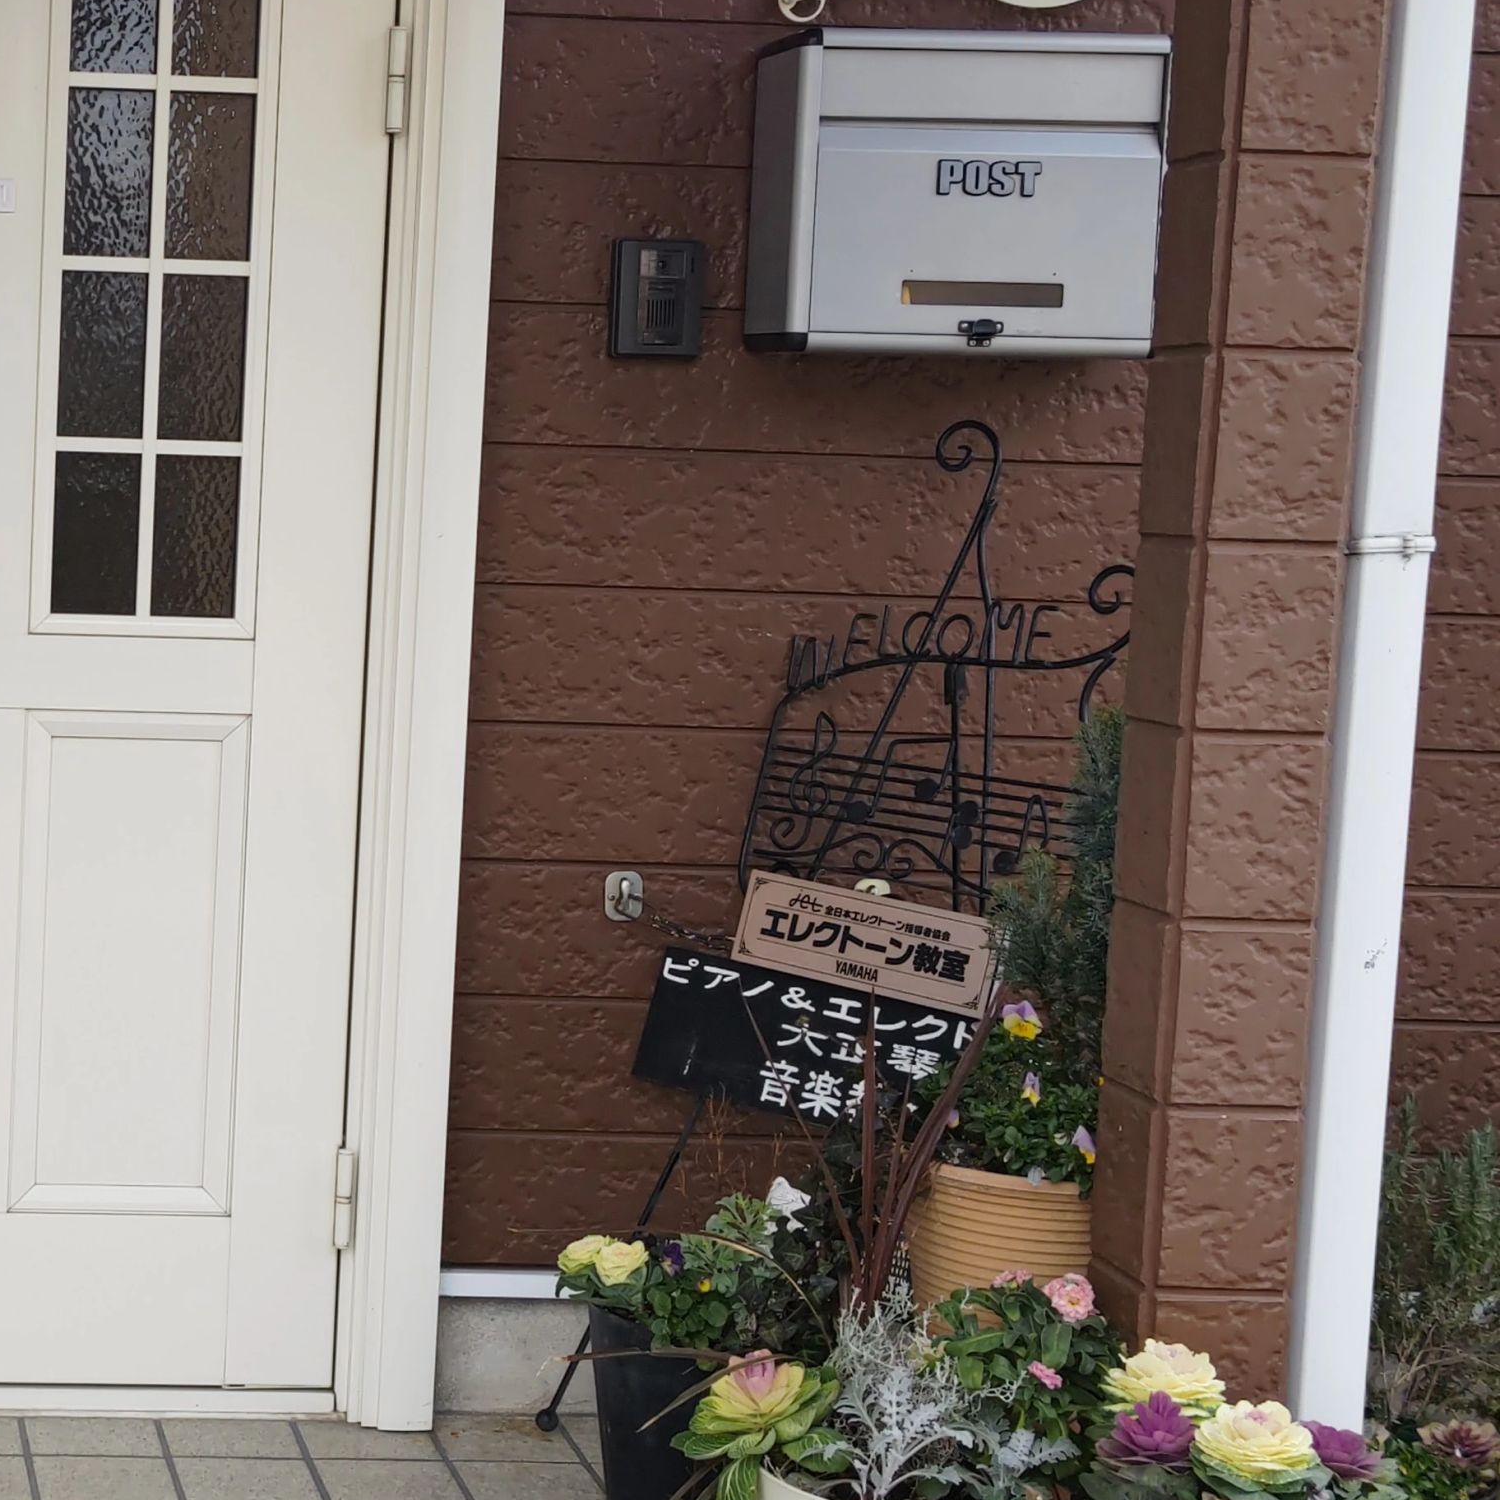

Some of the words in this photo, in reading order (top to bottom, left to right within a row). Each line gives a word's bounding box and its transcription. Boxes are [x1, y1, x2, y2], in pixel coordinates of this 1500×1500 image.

[936, 159, 1042, 197] POST
[788, 602, 1060, 689] WELCOME
[760, 908, 970, 982] エレクトーン教室
[835, 959, 879, 983] YAMAHA
